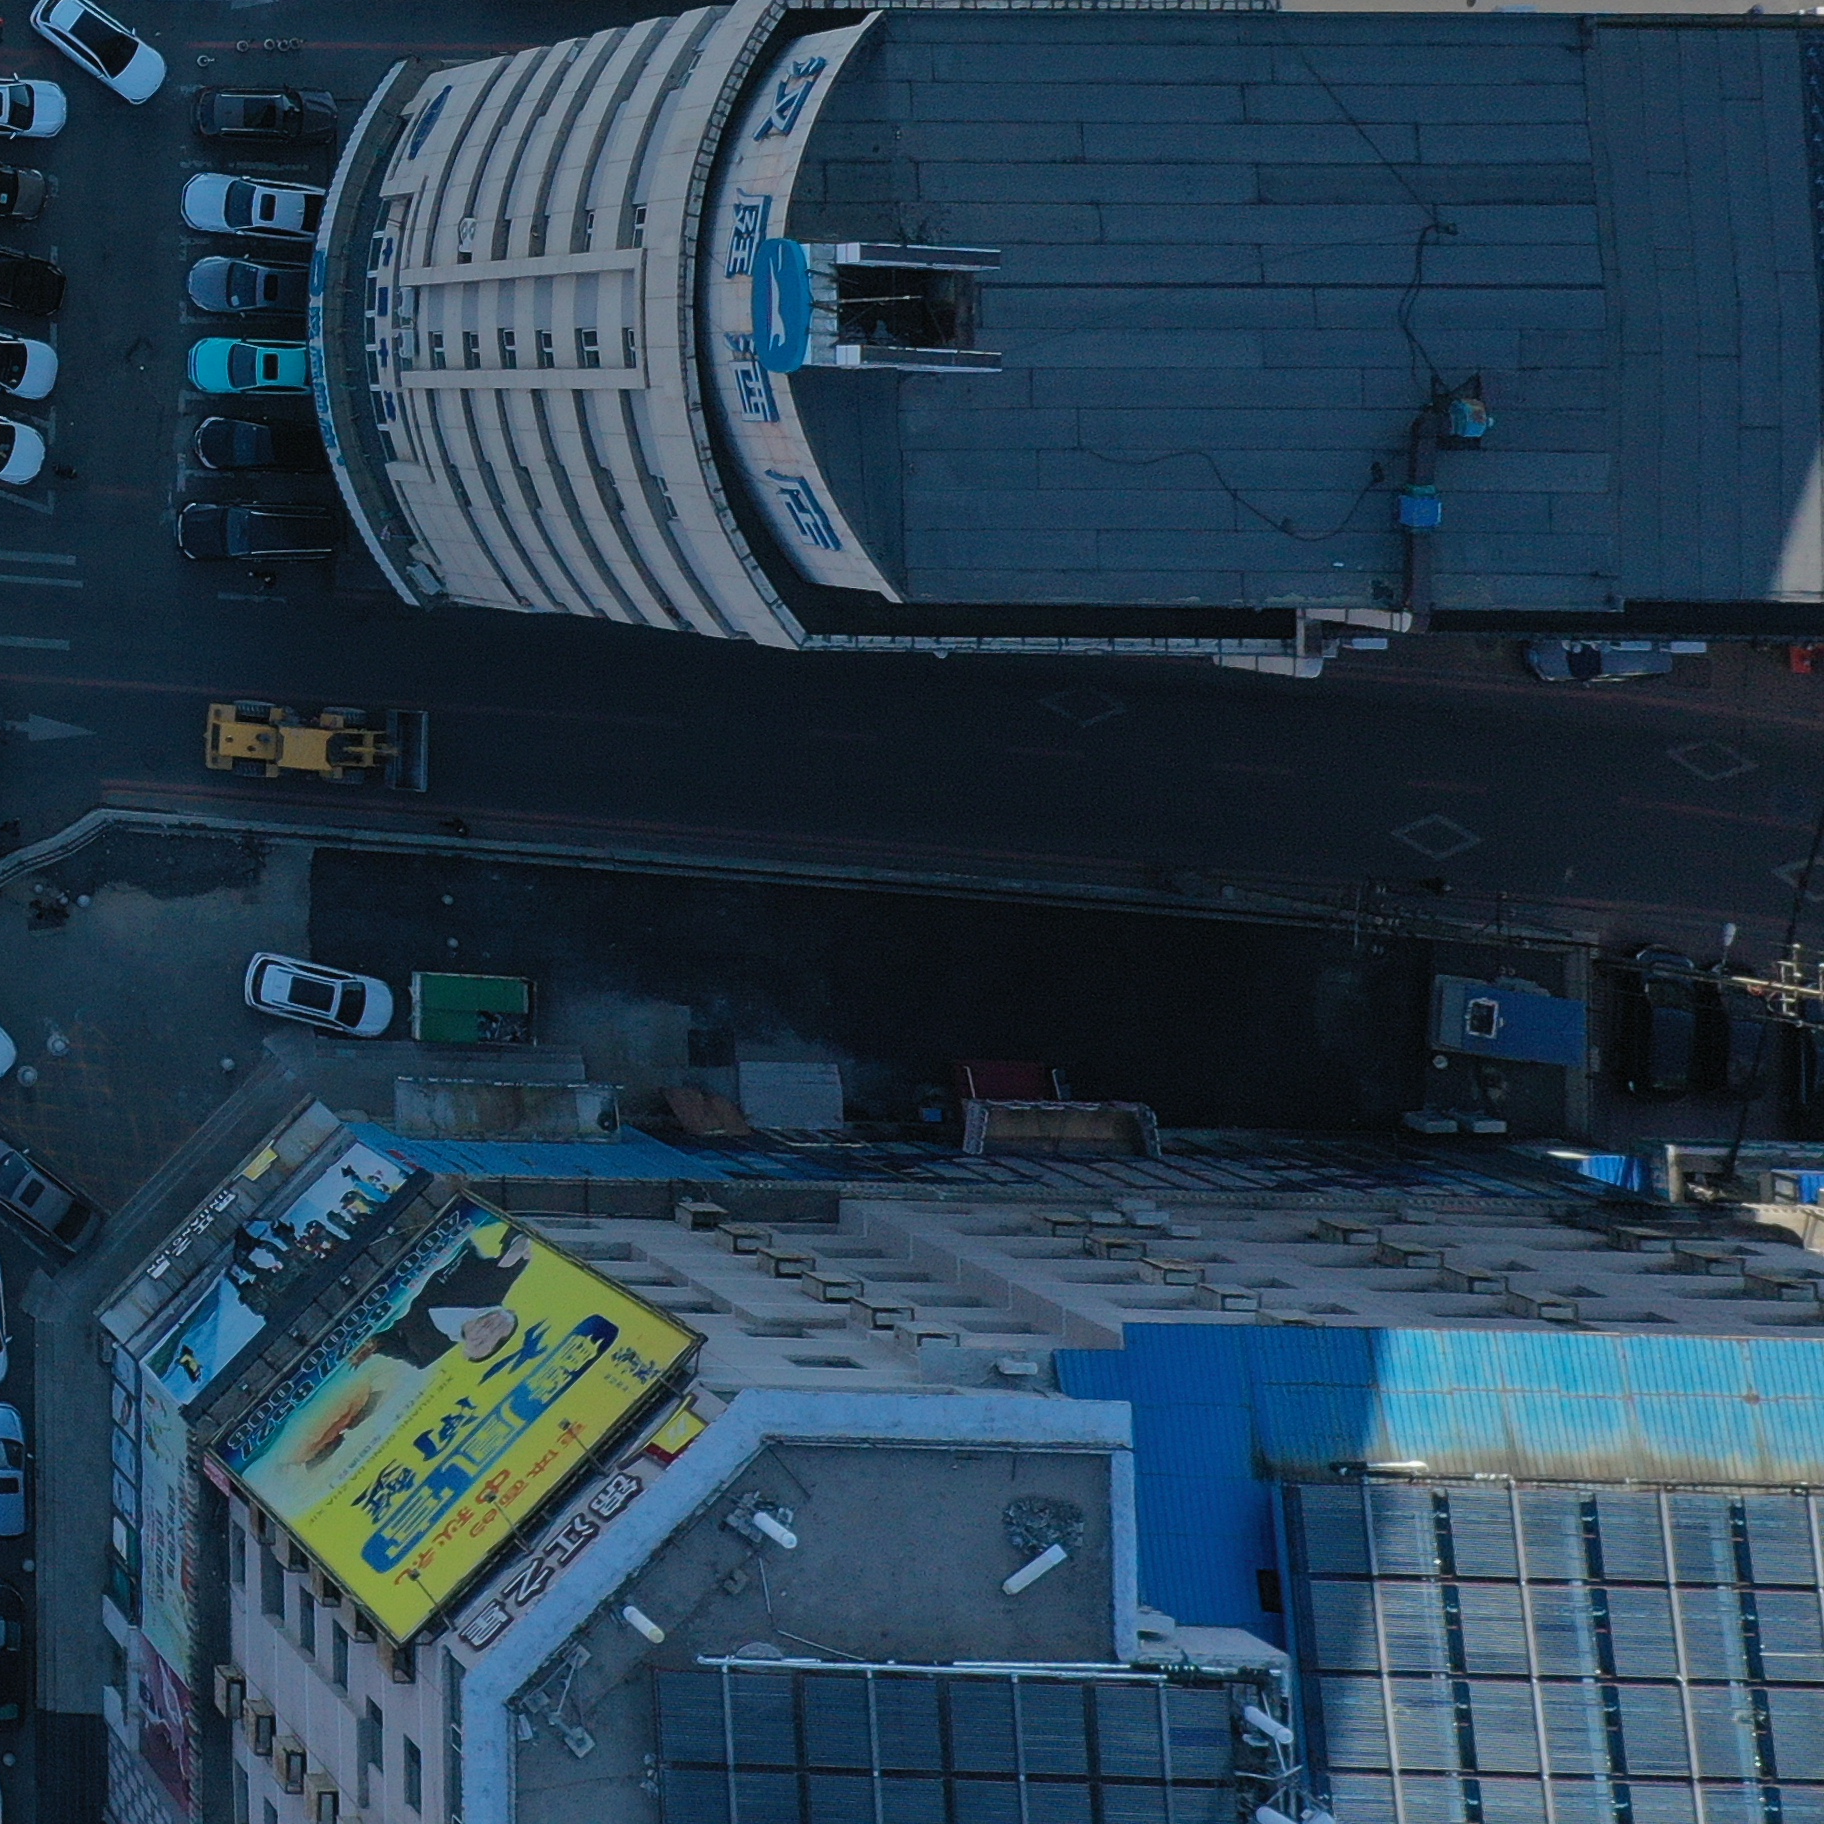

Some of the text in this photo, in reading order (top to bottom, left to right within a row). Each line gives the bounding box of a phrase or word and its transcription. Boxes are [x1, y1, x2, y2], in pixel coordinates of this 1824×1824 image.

[724, 56, 843, 551] 汉庭酒店
[223, 1208, 465, 1451] 400-0000-008
[312, 1298, 395, 1380] 8527
[234, 1378, 317, 1461] 8527
[348, 1314, 565, 1527] 大闸蟹
[464, 1418, 588, 1540] 更体面的
[389, 1466, 516, 1592] 中秋礼
[457, 1470, 646, 1655] 锦江之星
